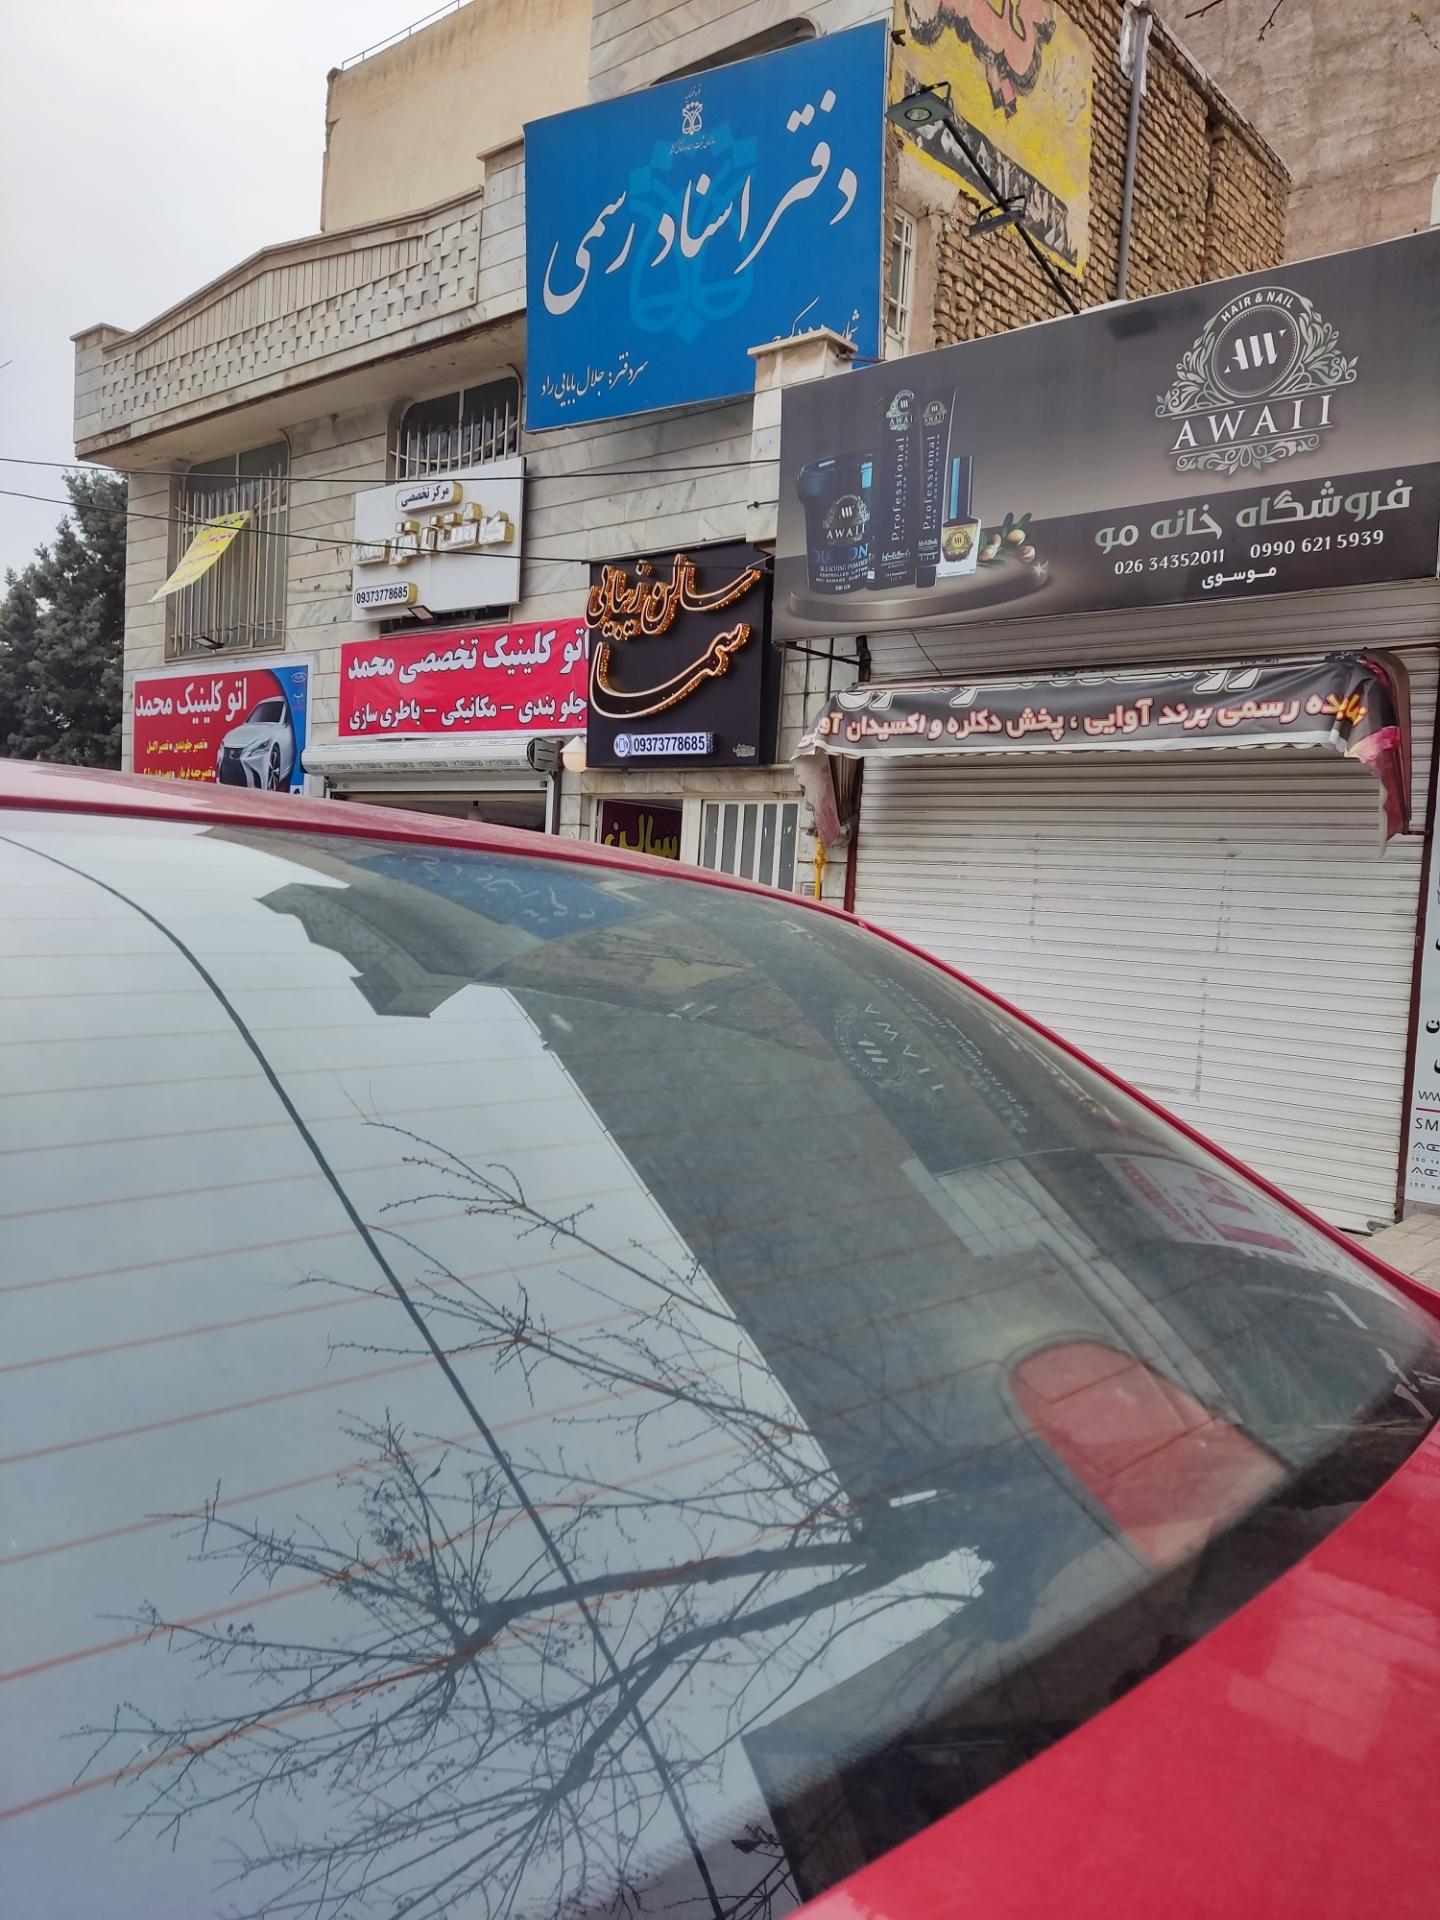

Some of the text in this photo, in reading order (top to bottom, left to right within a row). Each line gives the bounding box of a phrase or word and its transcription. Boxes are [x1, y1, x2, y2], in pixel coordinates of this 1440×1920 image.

[734, 89, 858, 275] دفتر
[651, 173, 752, 268] اسناد
[543, 190, 635, 315] رسمی
[1221, 290, 1294, 323] HAIR & NAIL
[541, 374, 554, 397] راد
[576, 365, 605, 397] جلال
[1172, 394, 1333, 450] AWAII
[400, 485, 450, 508] مرکز تخصصی
[891, 436, 905, 541] Professional
[922, 435, 936, 530] Professional
[1095, 478, 1414, 555] فروشگاه خانه مو
[1114, 529, 1385, 576] 026 34352011 0990 621 5939
[1201, 565, 1278, 589] موسوی
[356, 585, 408, 605] 09373778685
[584, 553, 758, 641] سالن زیبایی
[347, 627, 589, 684] اتو کلینیک تخصصی محمد
[589, 621, 750, 719] سما
[135, 694, 173, 717] محمد
[176, 680, 224, 725] کلینیک
[225, 677, 248, 722] اتو
[379, 698, 421, 728] باطری
[441, 695, 497, 726] مکانیکی
[518, 695, 556, 724] بندی
[558, 691, 588, 723] جلو
[1157, 701, 1214, 730] برند
[1215, 699, 1300, 728] رسمی
[349, 702, 378, 730] سازی
[845, 712, 927, 743] اکسیدان
[927, 717, 944, 740] و
[946, 708, 1002, 740] دکلره
[1005, 706, 1065, 741] پخش
[1083, 697, 1154, 737] آوایی
[633, 734, 706, 752] 09373778685
